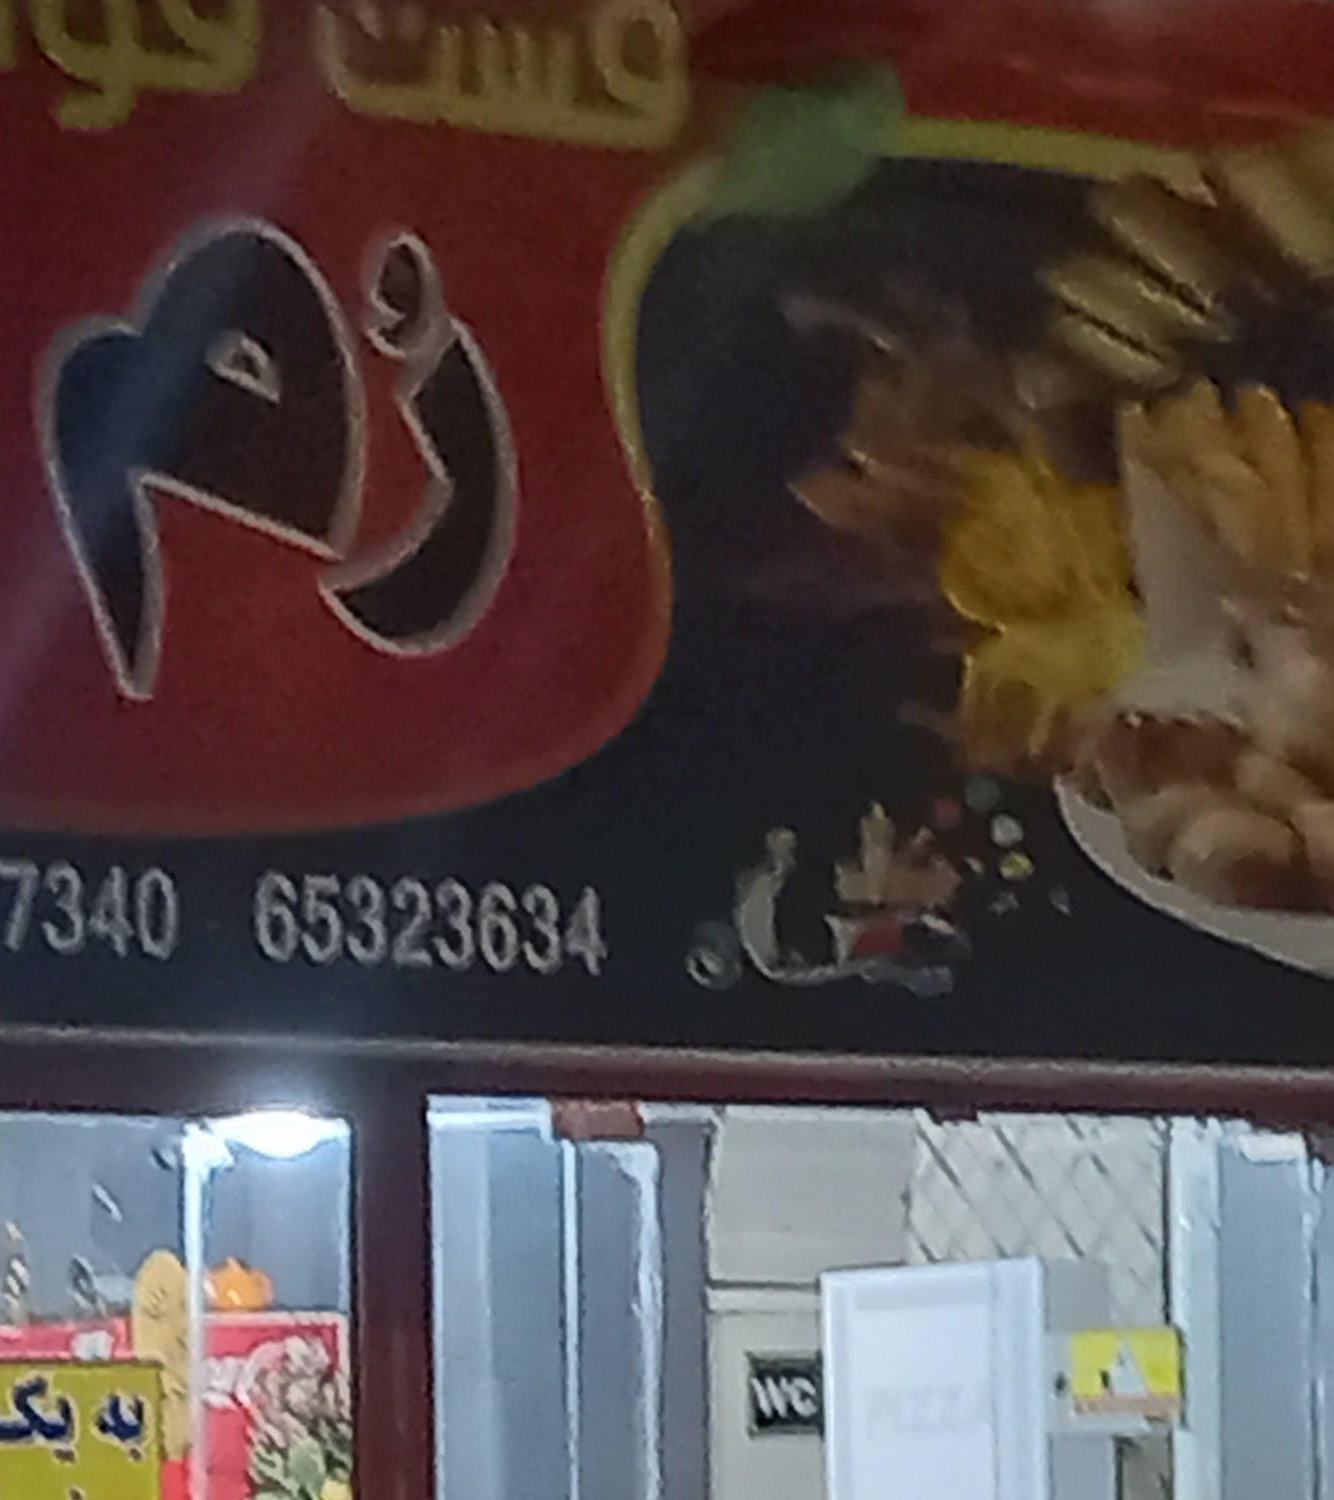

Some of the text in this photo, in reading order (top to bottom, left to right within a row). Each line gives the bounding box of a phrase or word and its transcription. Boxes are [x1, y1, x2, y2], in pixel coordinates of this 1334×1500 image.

[253, 869, 609, 977] 65323634
[93, 1391, 149, 1464] به
[750, 1375, 819, 1418] WC
